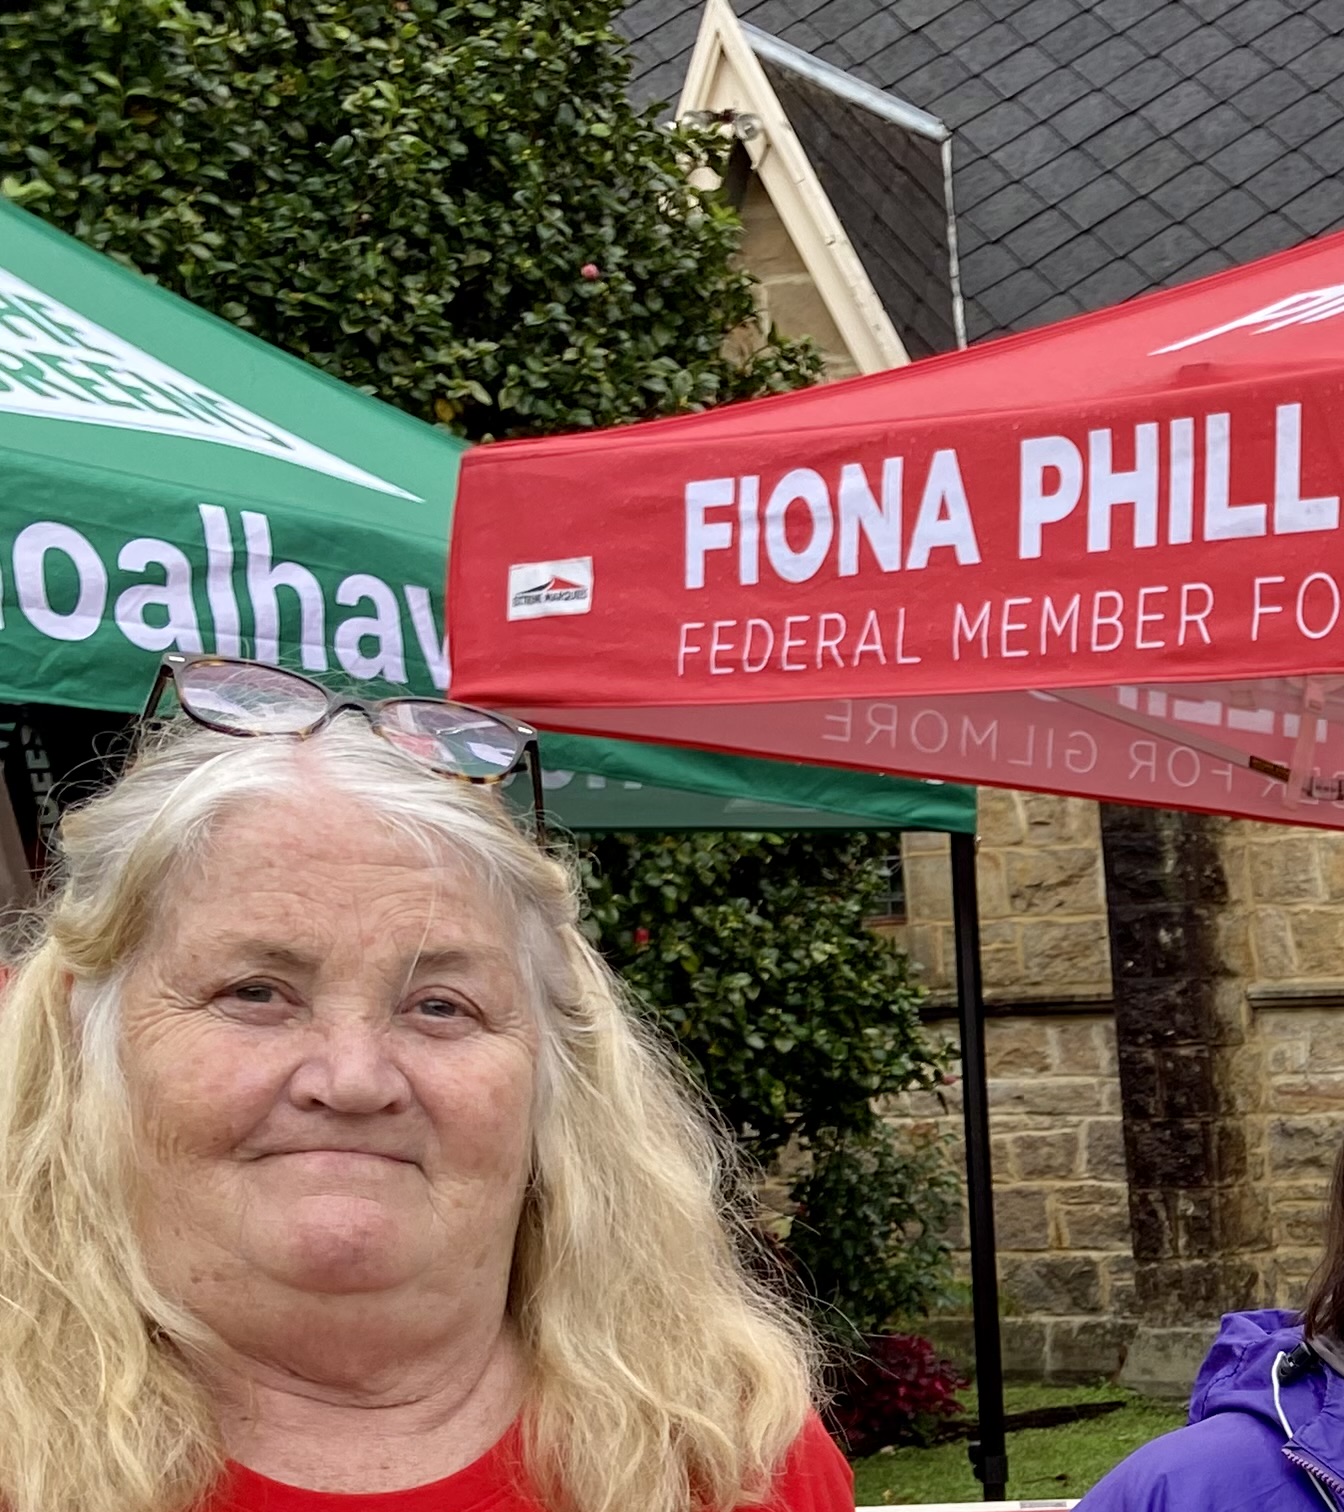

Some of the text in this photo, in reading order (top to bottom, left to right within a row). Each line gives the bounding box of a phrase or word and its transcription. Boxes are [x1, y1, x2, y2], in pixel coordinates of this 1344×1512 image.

[0, 349, 295, 450] REENS
[685, 449, 980, 589] FIONA
[0, 503, 450, 692] oalhav
[678, 606, 921, 675] FEDERAL
[953, 582, 1214, 660] MEMBER
